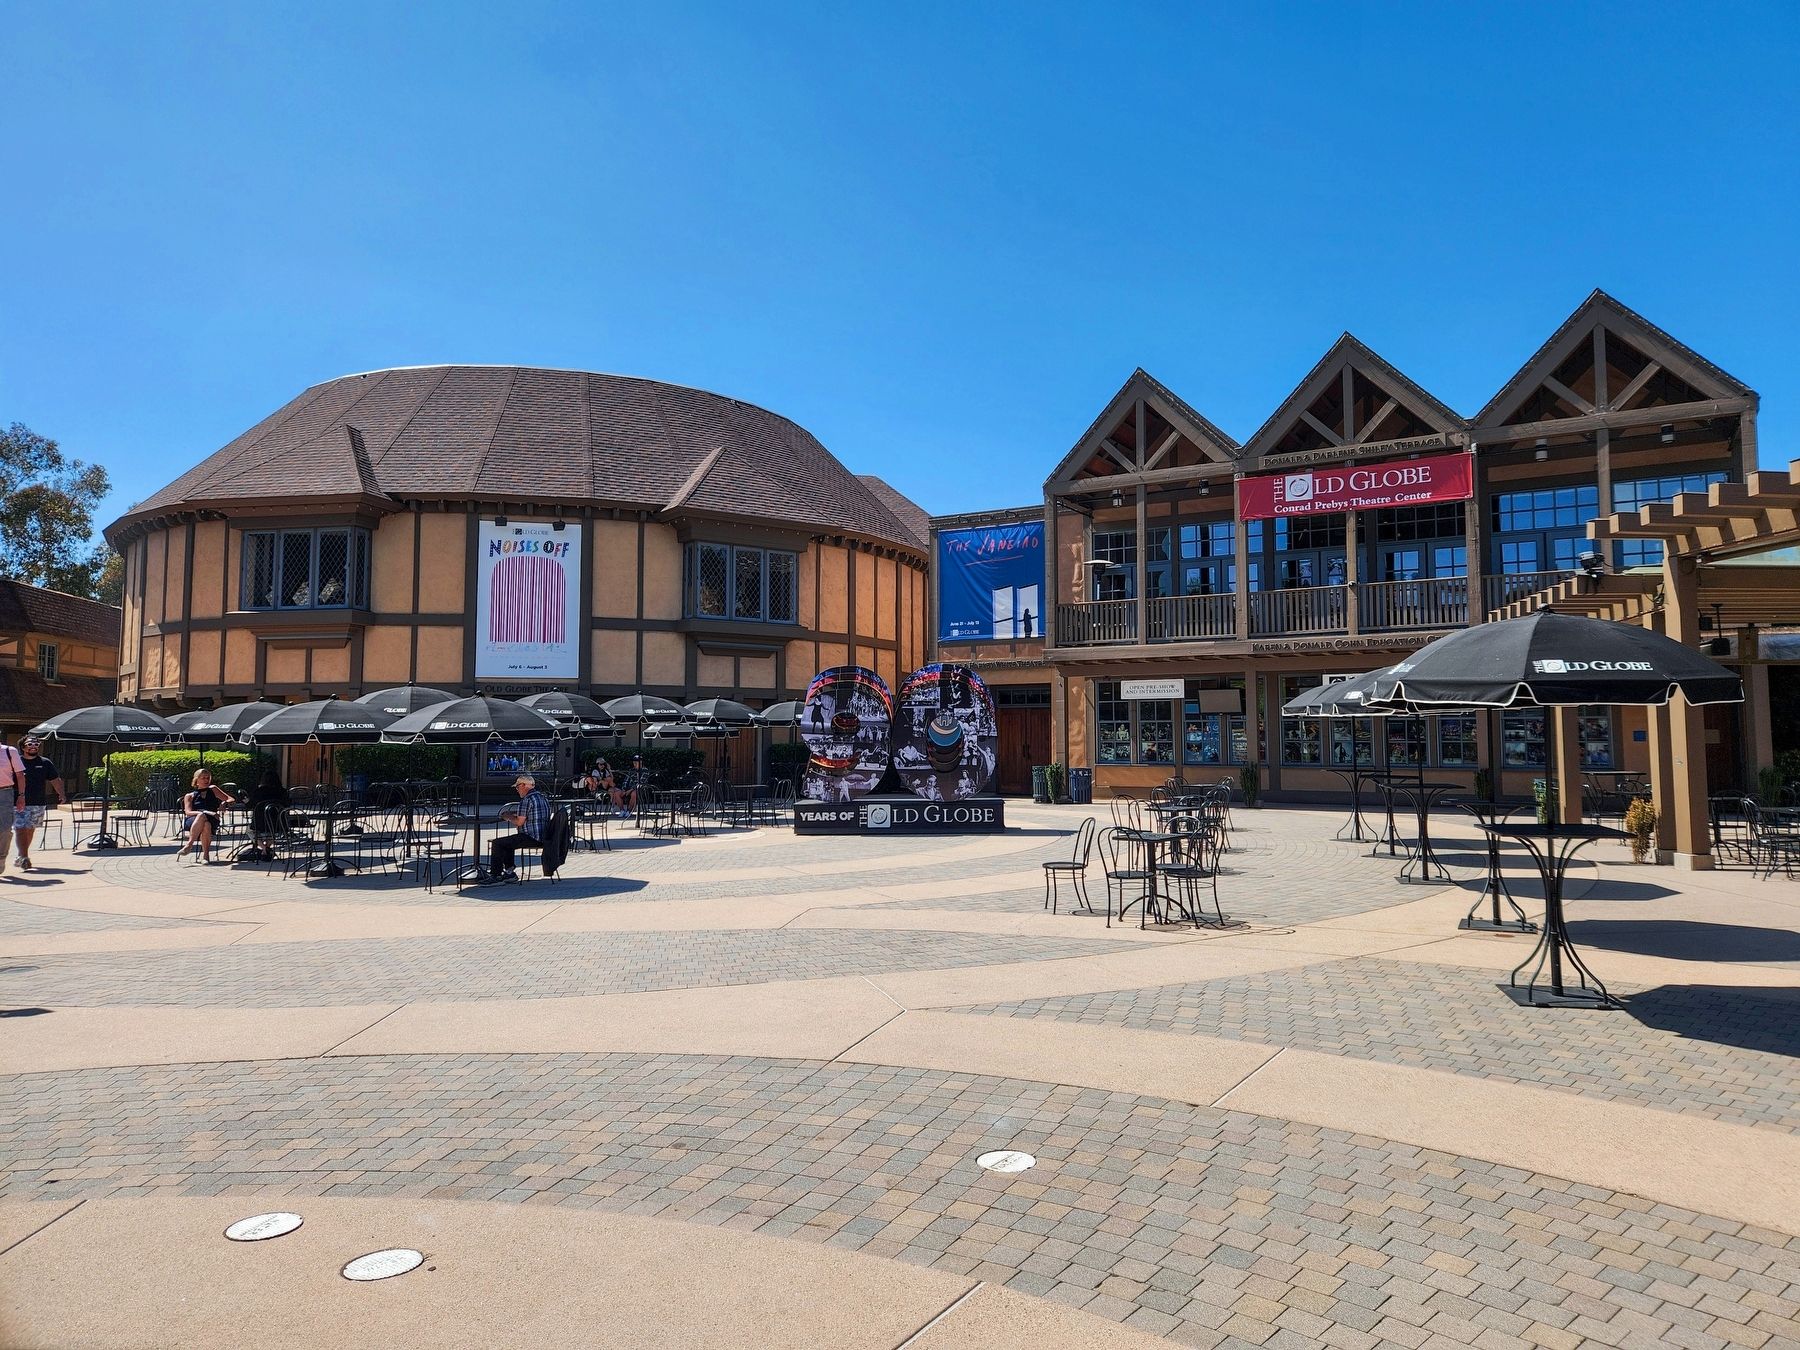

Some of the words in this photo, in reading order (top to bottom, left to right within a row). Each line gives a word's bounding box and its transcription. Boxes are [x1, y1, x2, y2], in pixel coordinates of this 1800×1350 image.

[1263, 456, 1302, 467] DONALD
[1312, 448, 1356, 460] DARLENE
[1358, 443, 1393, 455] SHILEY
[1393, 437, 1441, 451] TERRACE
[1273, 477, 1284, 503] THE
[1349, 466, 1432, 491] GLOBE
[1274, 502, 1311, 513] Conrad
[1314, 500, 1348, 510] Prebys
[1350, 497, 1391, 507] Theatre
[1394, 492, 1432, 502] Center
[489, 540, 539, 557] NOISES
[543, 540, 570, 557] OFF
[946, 539, 971, 555] THE
[1251, 642, 1283, 652] KAREN
[1292, 641, 1333, 651] DONALD
[1365, 637, 1424, 647] EDUCATION
[1532, 660, 1545, 673] THE
[1589, 660, 1654, 671] GLOBE
[505, 685, 531, 693] GLOBE
[533, 685, 568, 693] THERE
[799, 811, 837, 822] YEARS
[839, 811, 855, 821] OF
[859, 805, 868, 827] THE
[923, 804, 996, 823] GLOBE
